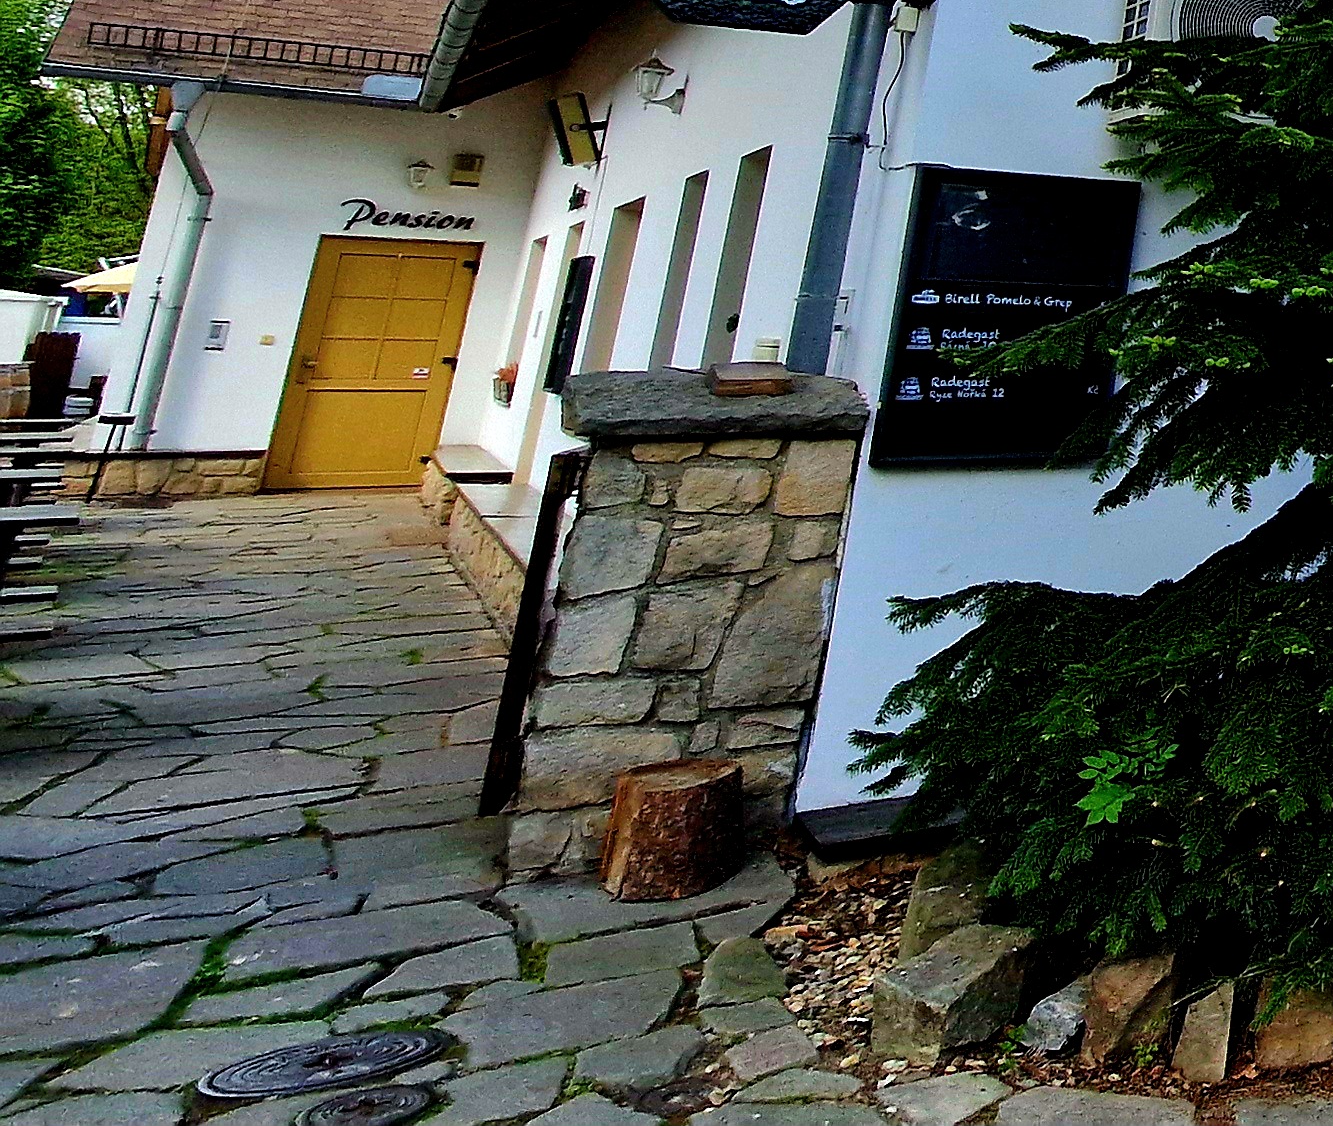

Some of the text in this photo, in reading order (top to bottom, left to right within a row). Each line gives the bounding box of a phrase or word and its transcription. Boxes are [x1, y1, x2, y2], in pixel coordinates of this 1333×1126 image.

[340, 197, 476, 232] Pension
[944, 293, 981, 304] Birell
[986, 293, 1032, 306] Pomelo
[942, 328, 1000, 342] Radegast
[932, 376, 990, 391] Radegast
[992, 388, 1005, 398] 12
